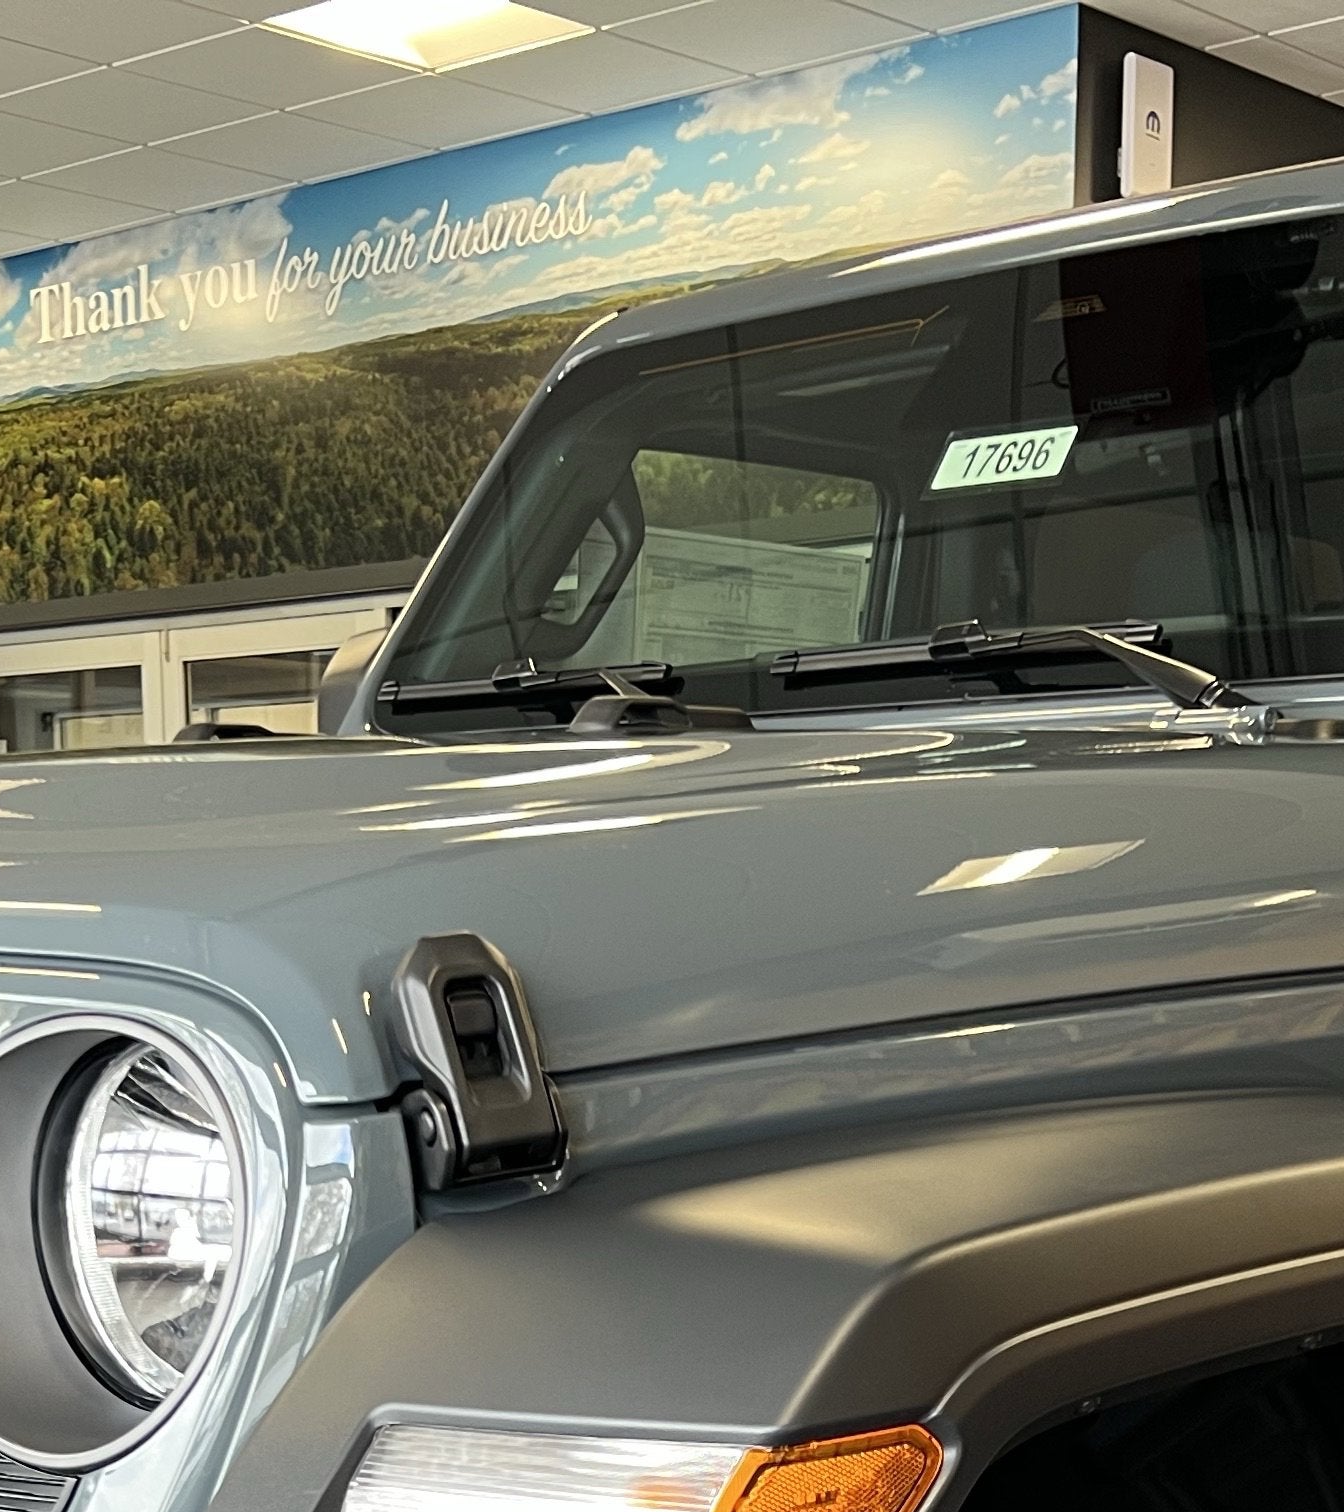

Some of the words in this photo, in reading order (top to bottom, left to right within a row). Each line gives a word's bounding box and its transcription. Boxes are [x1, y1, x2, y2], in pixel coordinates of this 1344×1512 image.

[30, 264, 166, 344] Thank
[179, 256, 259, 331] you
[264, 238, 323, 322] for
[328, 230, 420, 316] your
[427, 192, 594, 265] business
[962, 437, 1055, 478] 17696
